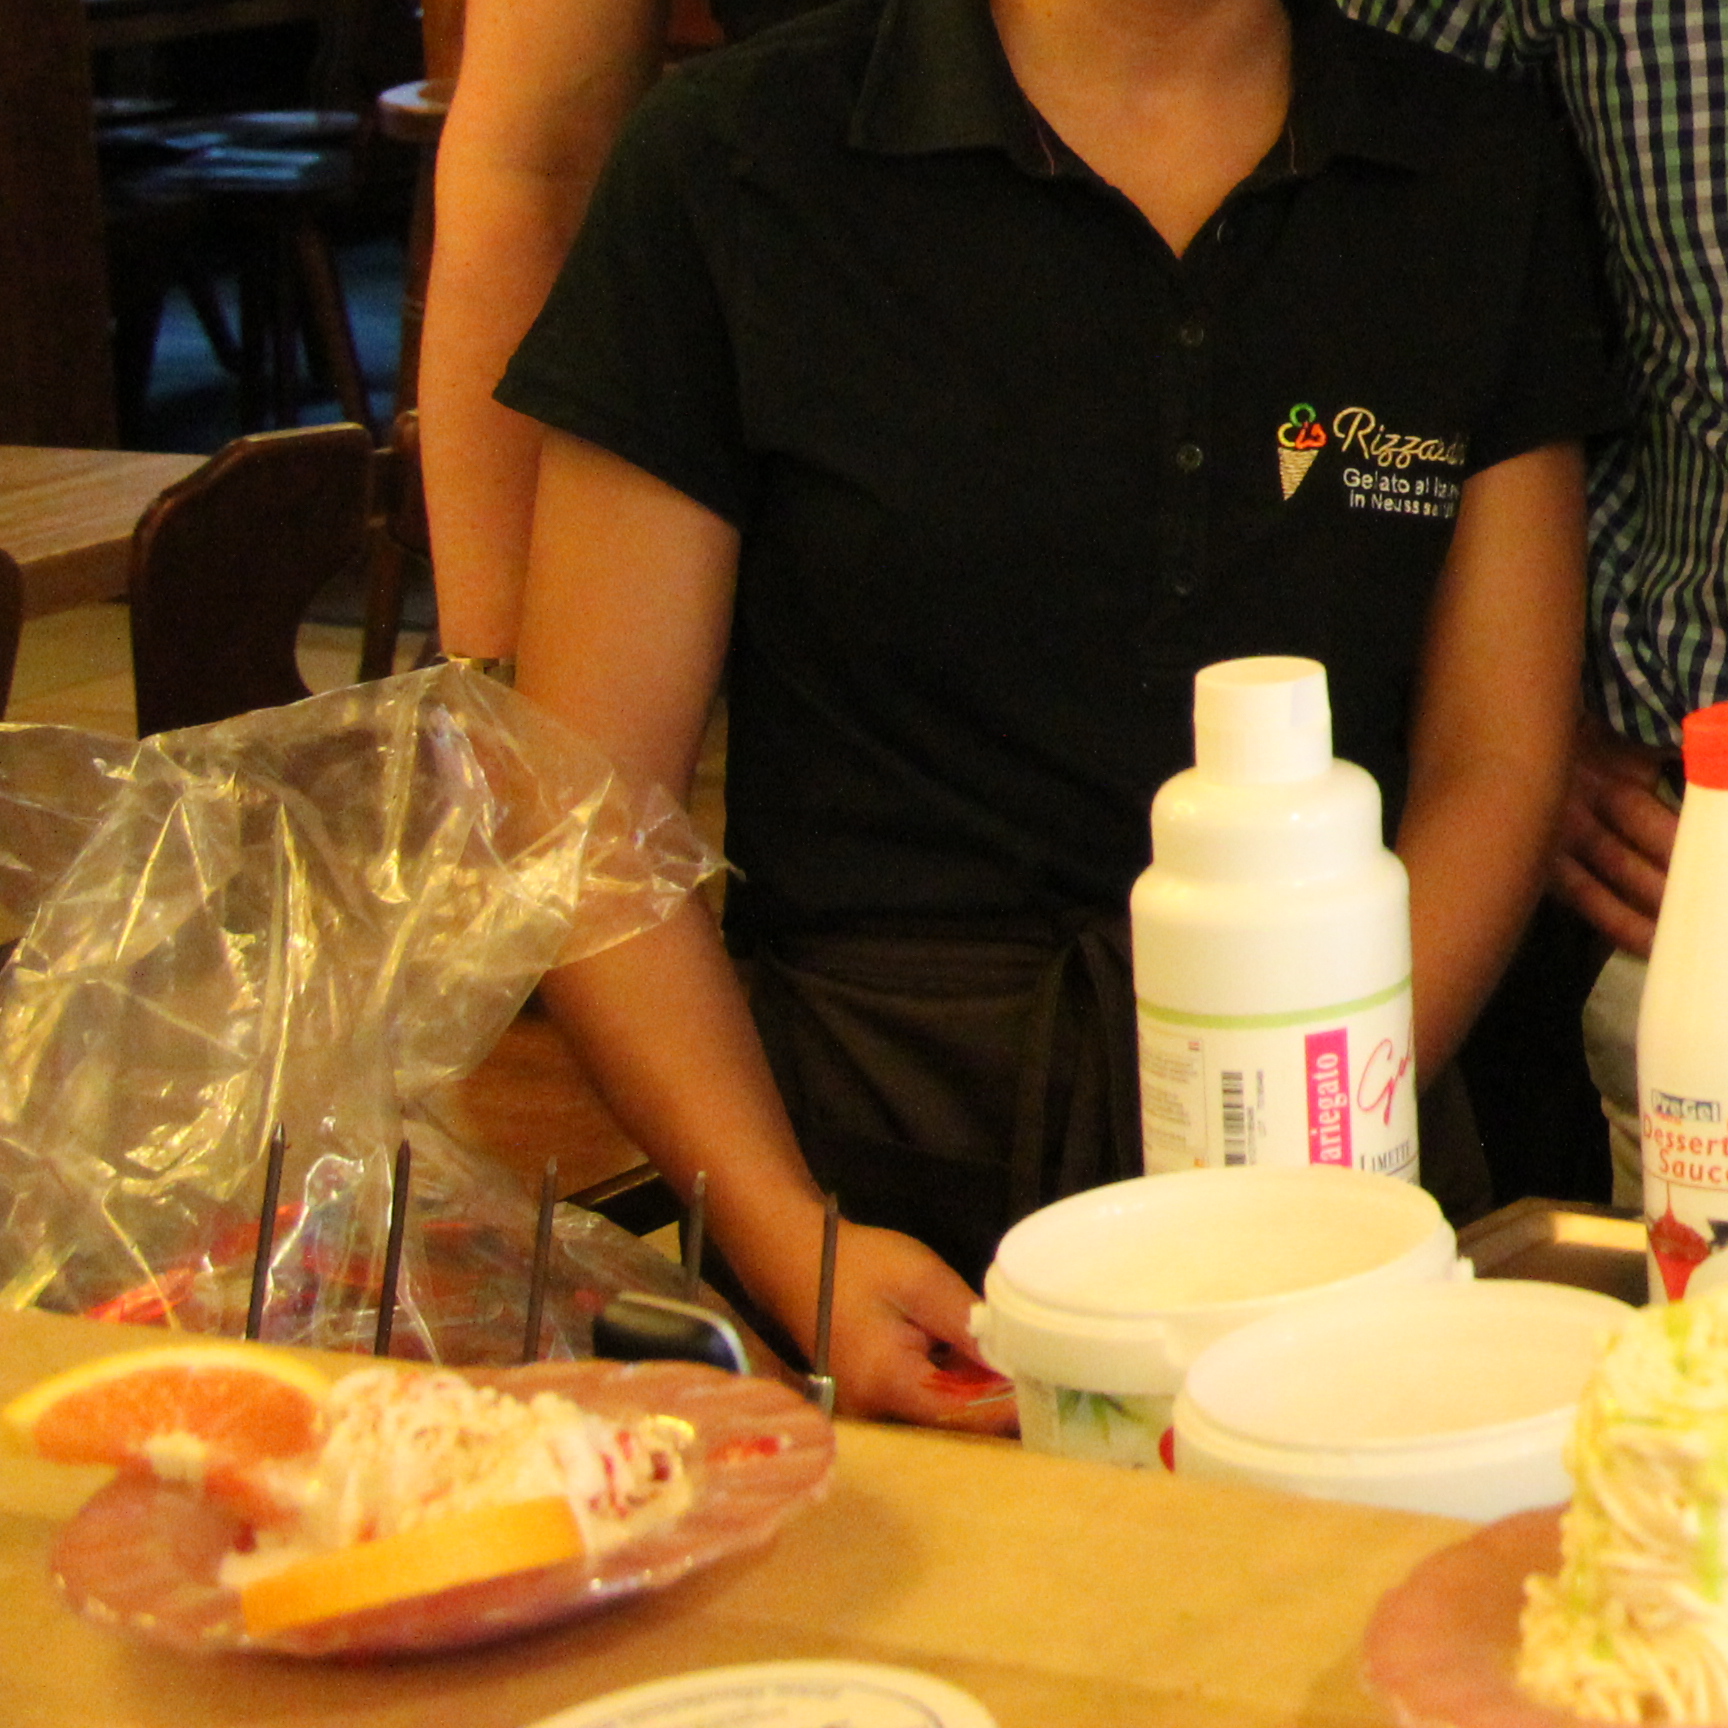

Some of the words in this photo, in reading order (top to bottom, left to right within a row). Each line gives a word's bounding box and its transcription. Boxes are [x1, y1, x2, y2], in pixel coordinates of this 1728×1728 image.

[1343, 468, 1410, 493] Gelato
[1350, 489, 1365, 507] in
[1371, 493, 1420, 514] Neuss
[1302, 1052, 1348, 1162] ariegato
